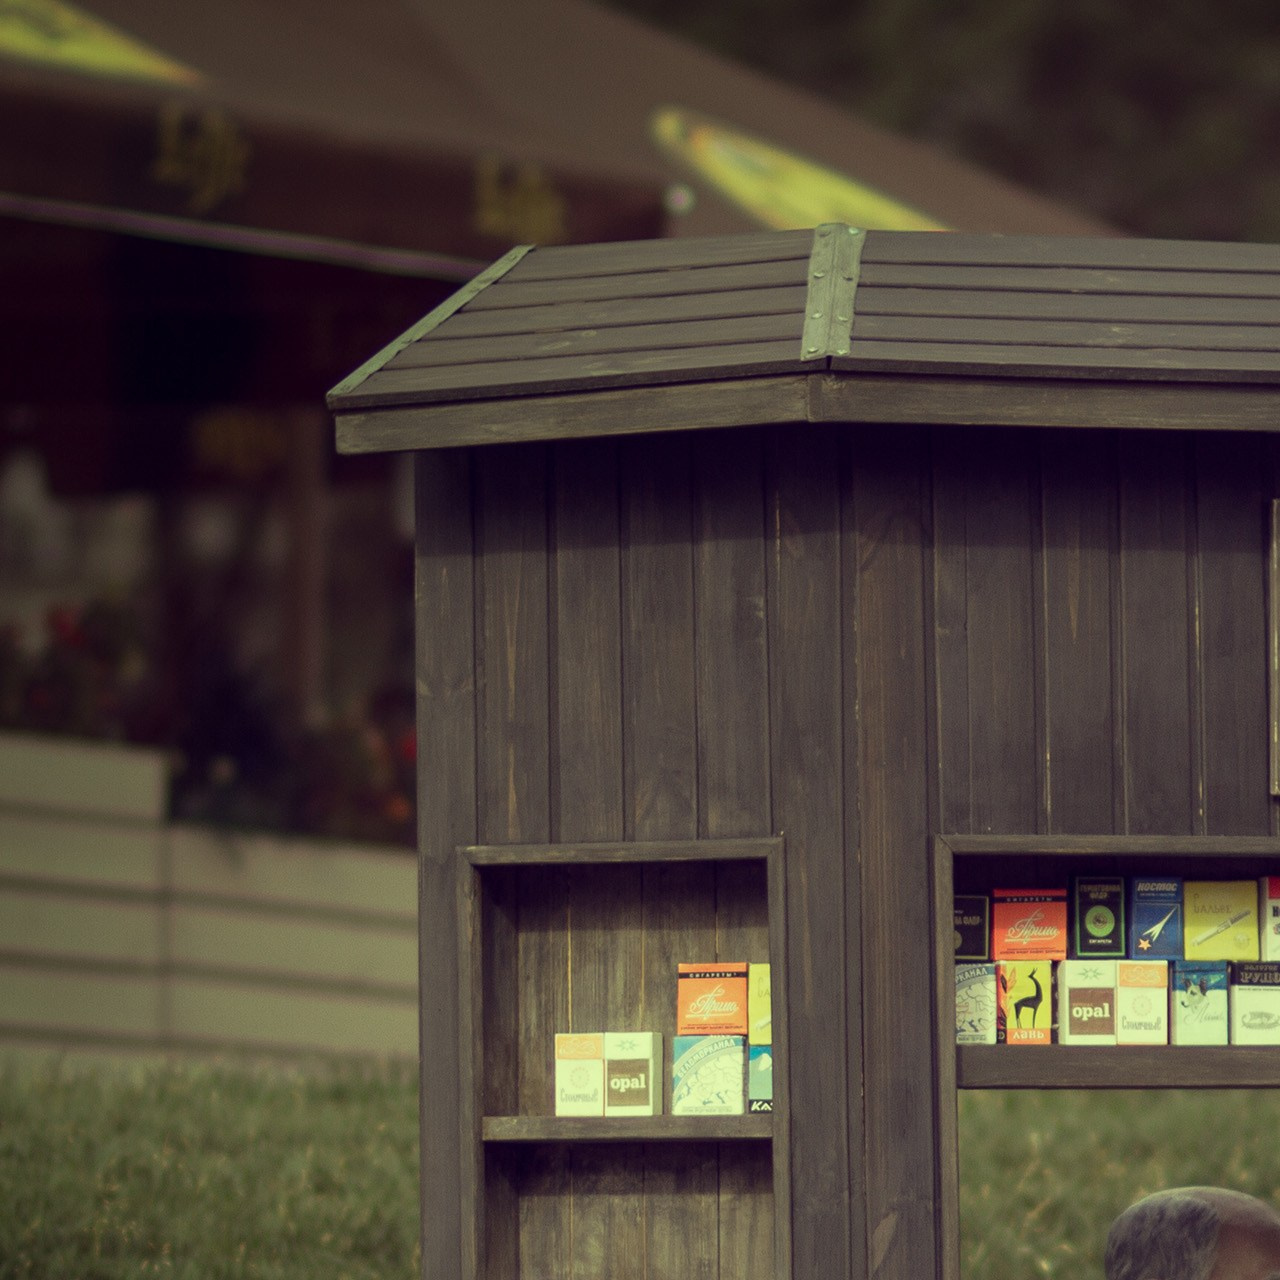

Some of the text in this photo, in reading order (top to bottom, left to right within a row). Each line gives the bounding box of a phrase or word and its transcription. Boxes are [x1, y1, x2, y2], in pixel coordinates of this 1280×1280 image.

[1072, 1002, 1111, 1021] opal
[676, 1038, 736, 1078] БЕЛОМОРКАНАЛ
[610, 1073, 646, 1093] opal
[751, 1101, 773, 1111] КА
